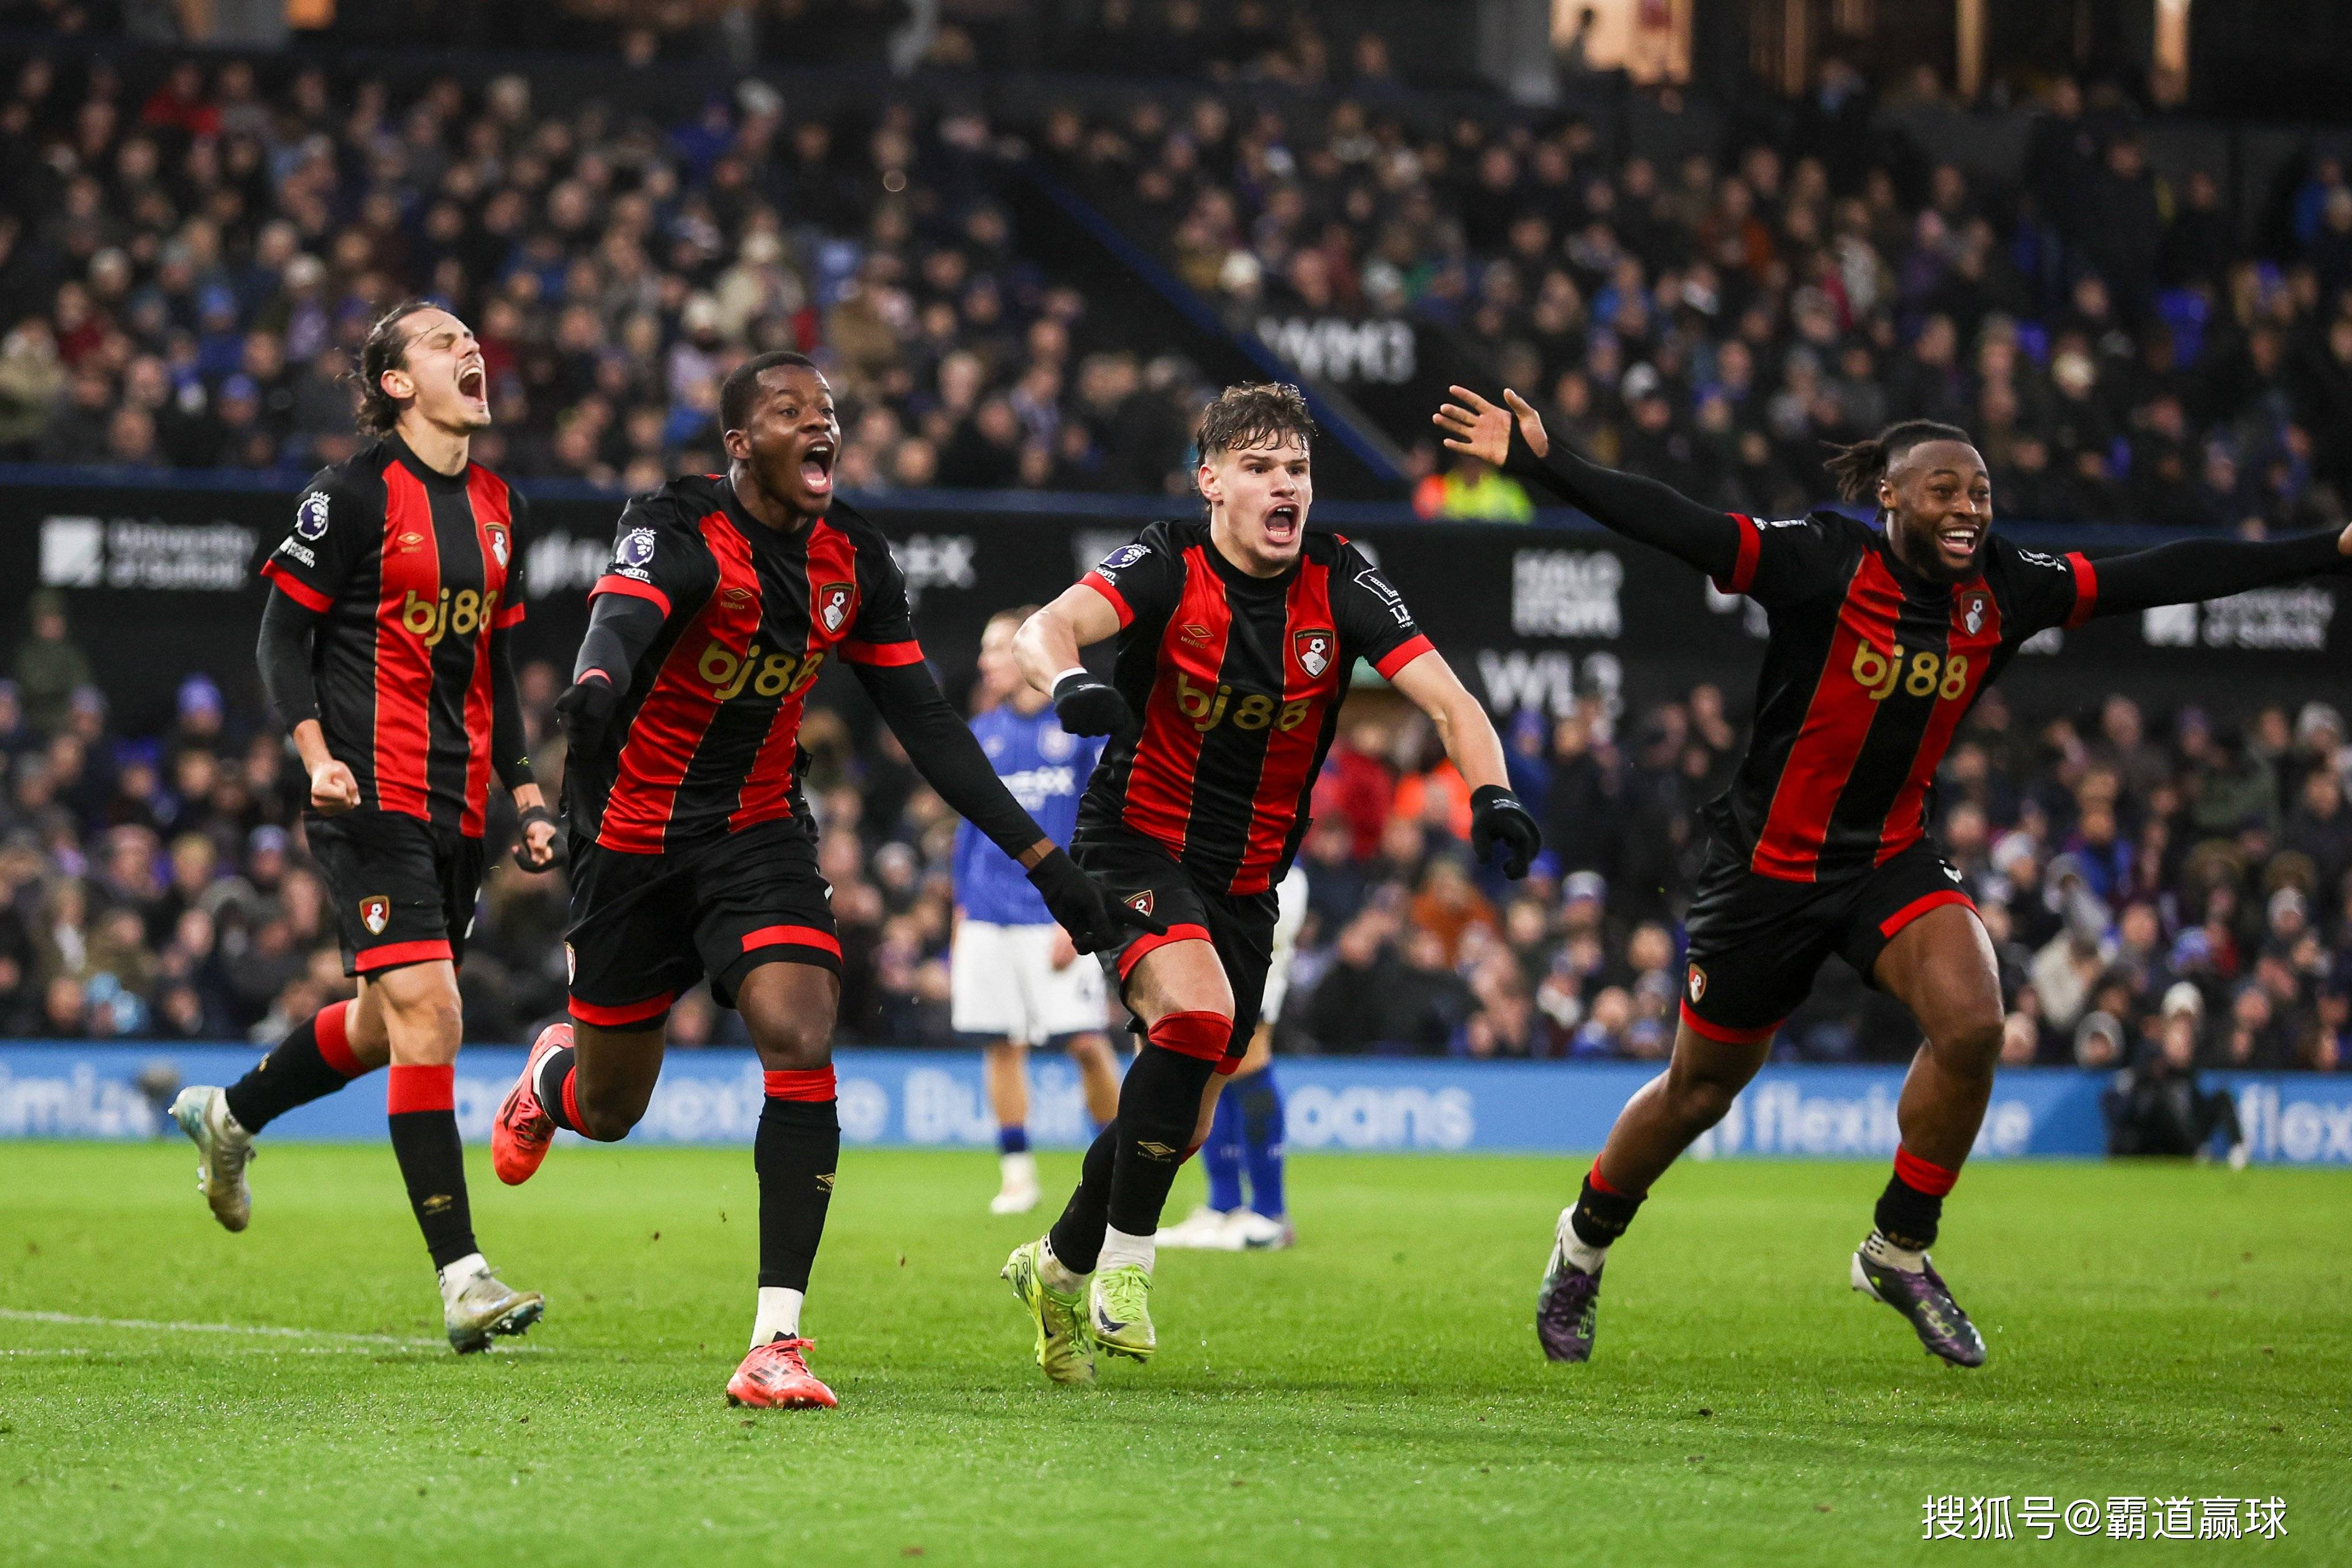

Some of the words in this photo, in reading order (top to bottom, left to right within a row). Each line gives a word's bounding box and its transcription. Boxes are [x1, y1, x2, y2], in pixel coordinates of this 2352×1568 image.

[403, 587, 498, 646] bj88
[698, 639, 825, 700] bj88
[1852, 639, 1968, 700] bj88
[1177, 673, 1312, 731] bj88
[1284, 1084, 1475, 1151] oans
[1755, 1082, 2033, 1155] flexie
